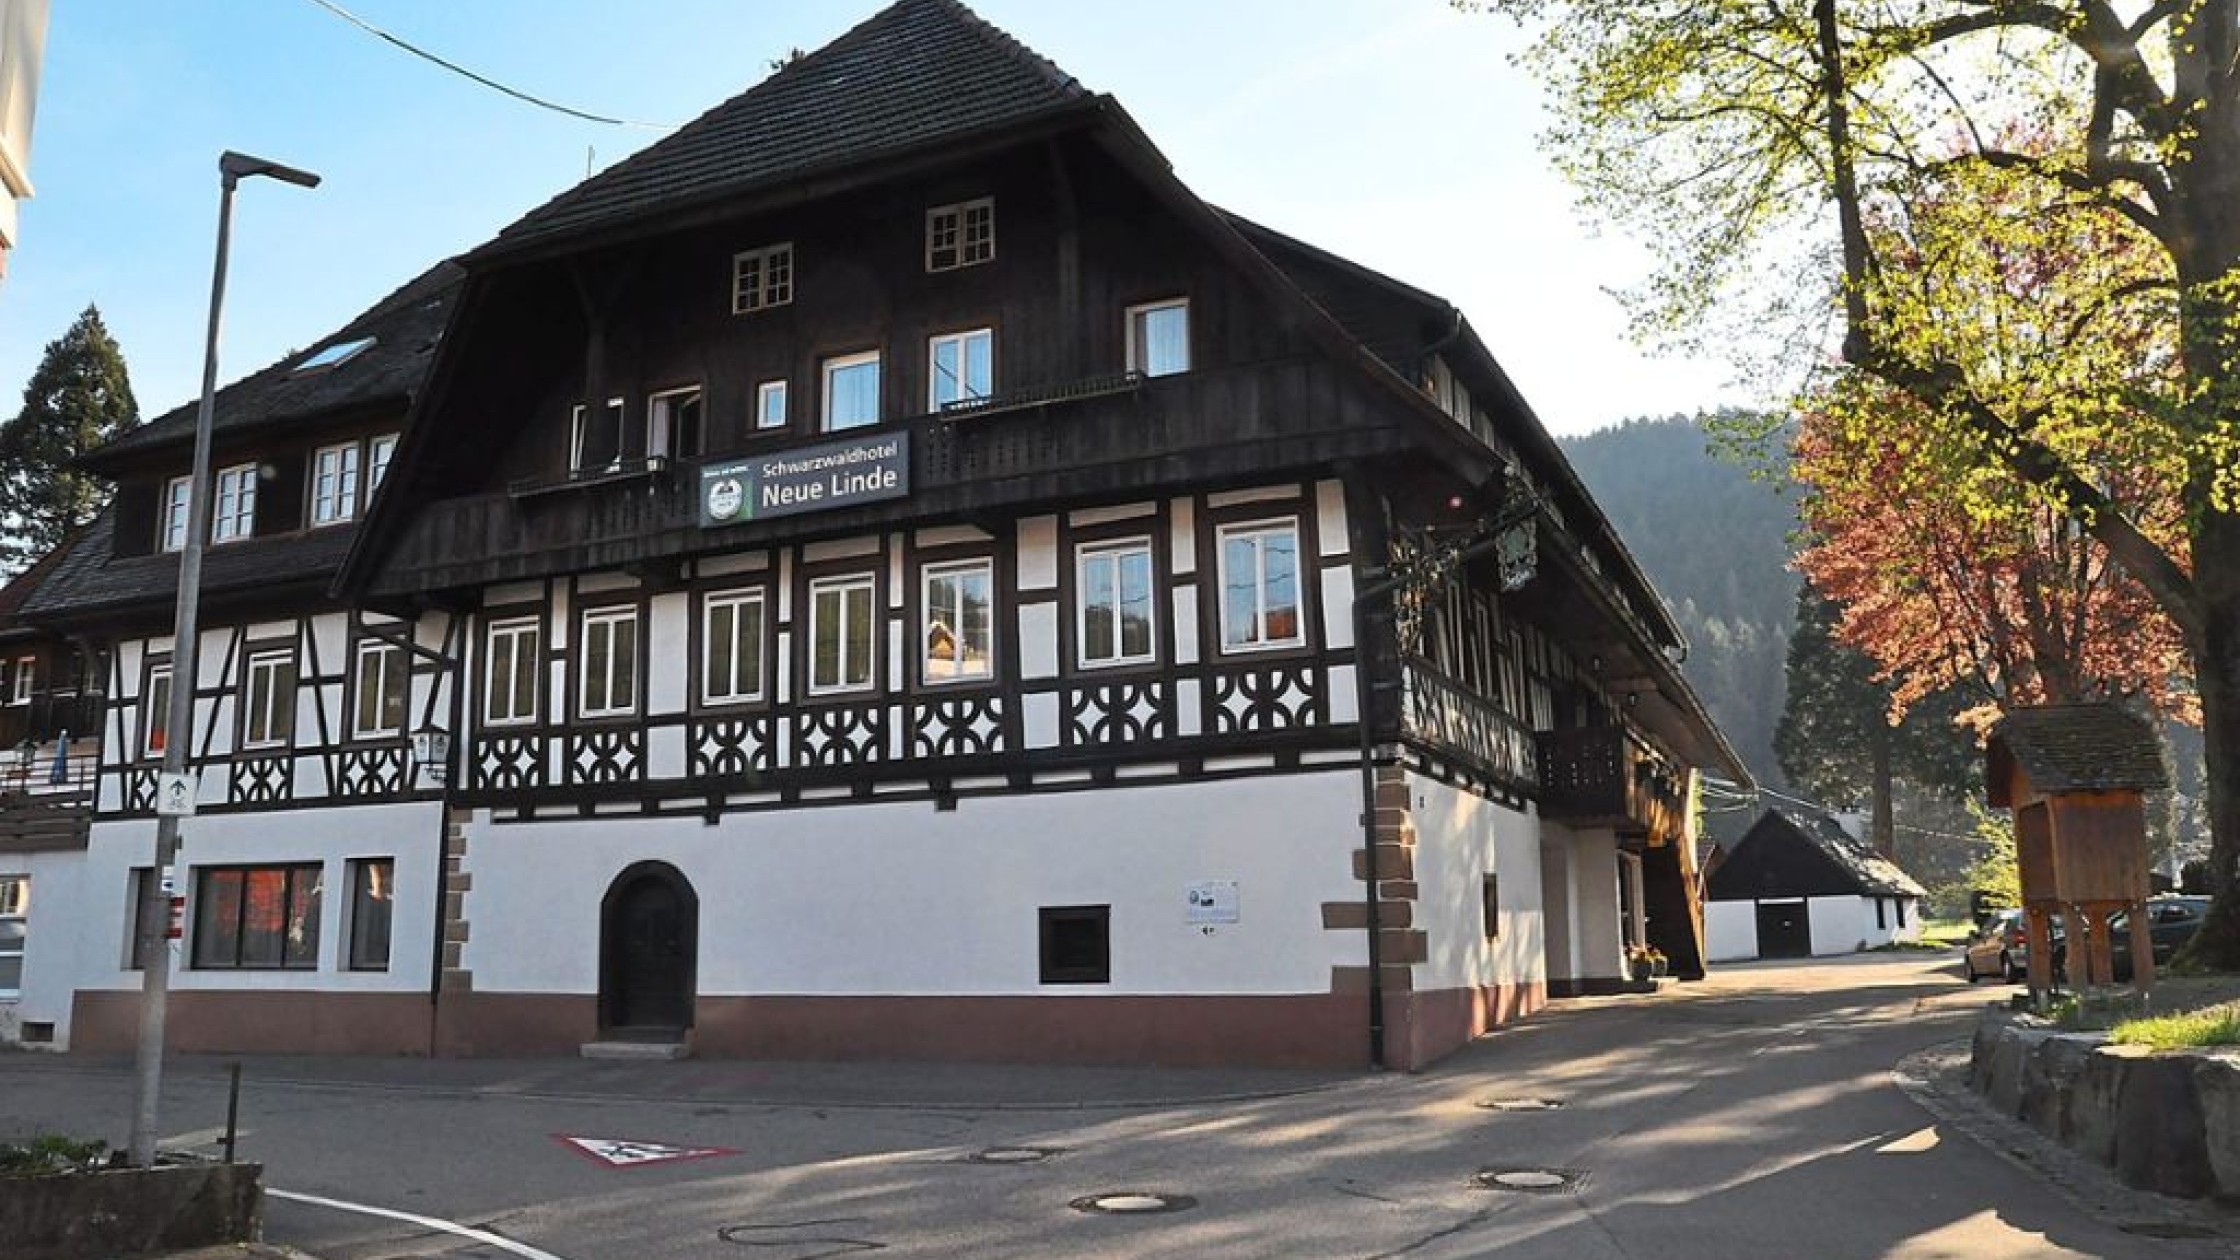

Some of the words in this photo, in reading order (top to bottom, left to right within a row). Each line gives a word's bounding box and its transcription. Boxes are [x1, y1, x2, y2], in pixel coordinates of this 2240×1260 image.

[762, 440, 898, 478] Schwarzwaldhotel
[762, 481, 824, 508] Neue
[831, 465, 898, 496] Linde
